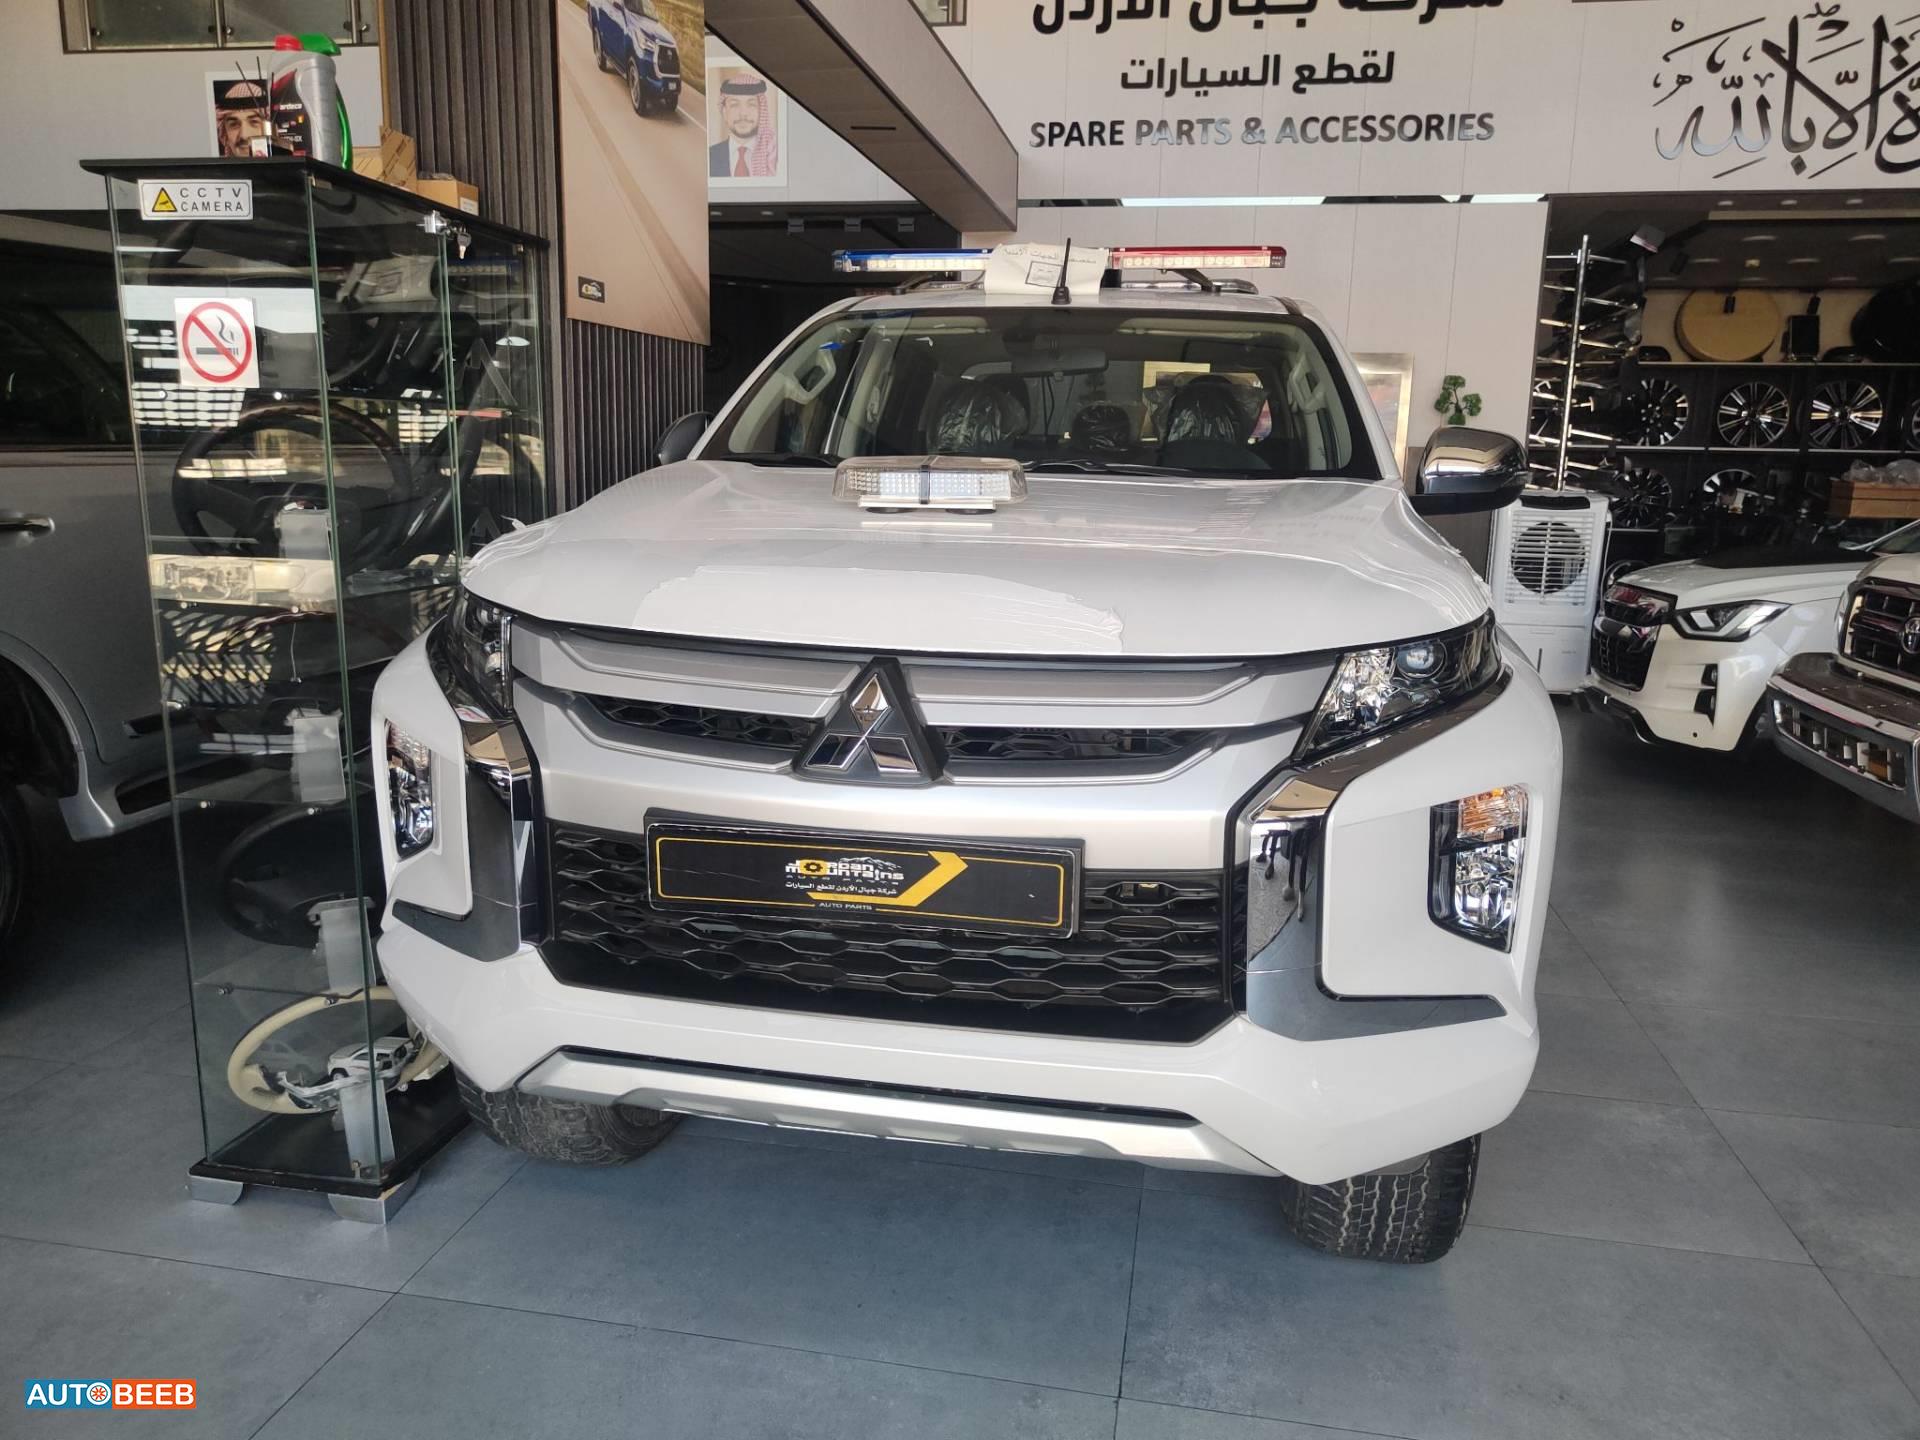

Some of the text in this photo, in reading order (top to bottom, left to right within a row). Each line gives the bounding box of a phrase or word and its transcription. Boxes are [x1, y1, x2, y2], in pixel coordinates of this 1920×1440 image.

[1121, 50, 1395, 97] لقطع السيارات
[1029, 112, 1495, 148] SPARE PARTS & ACCESSORIES
[180, 187, 242, 198] CCTV
[180, 201, 244, 212] CAMERA
